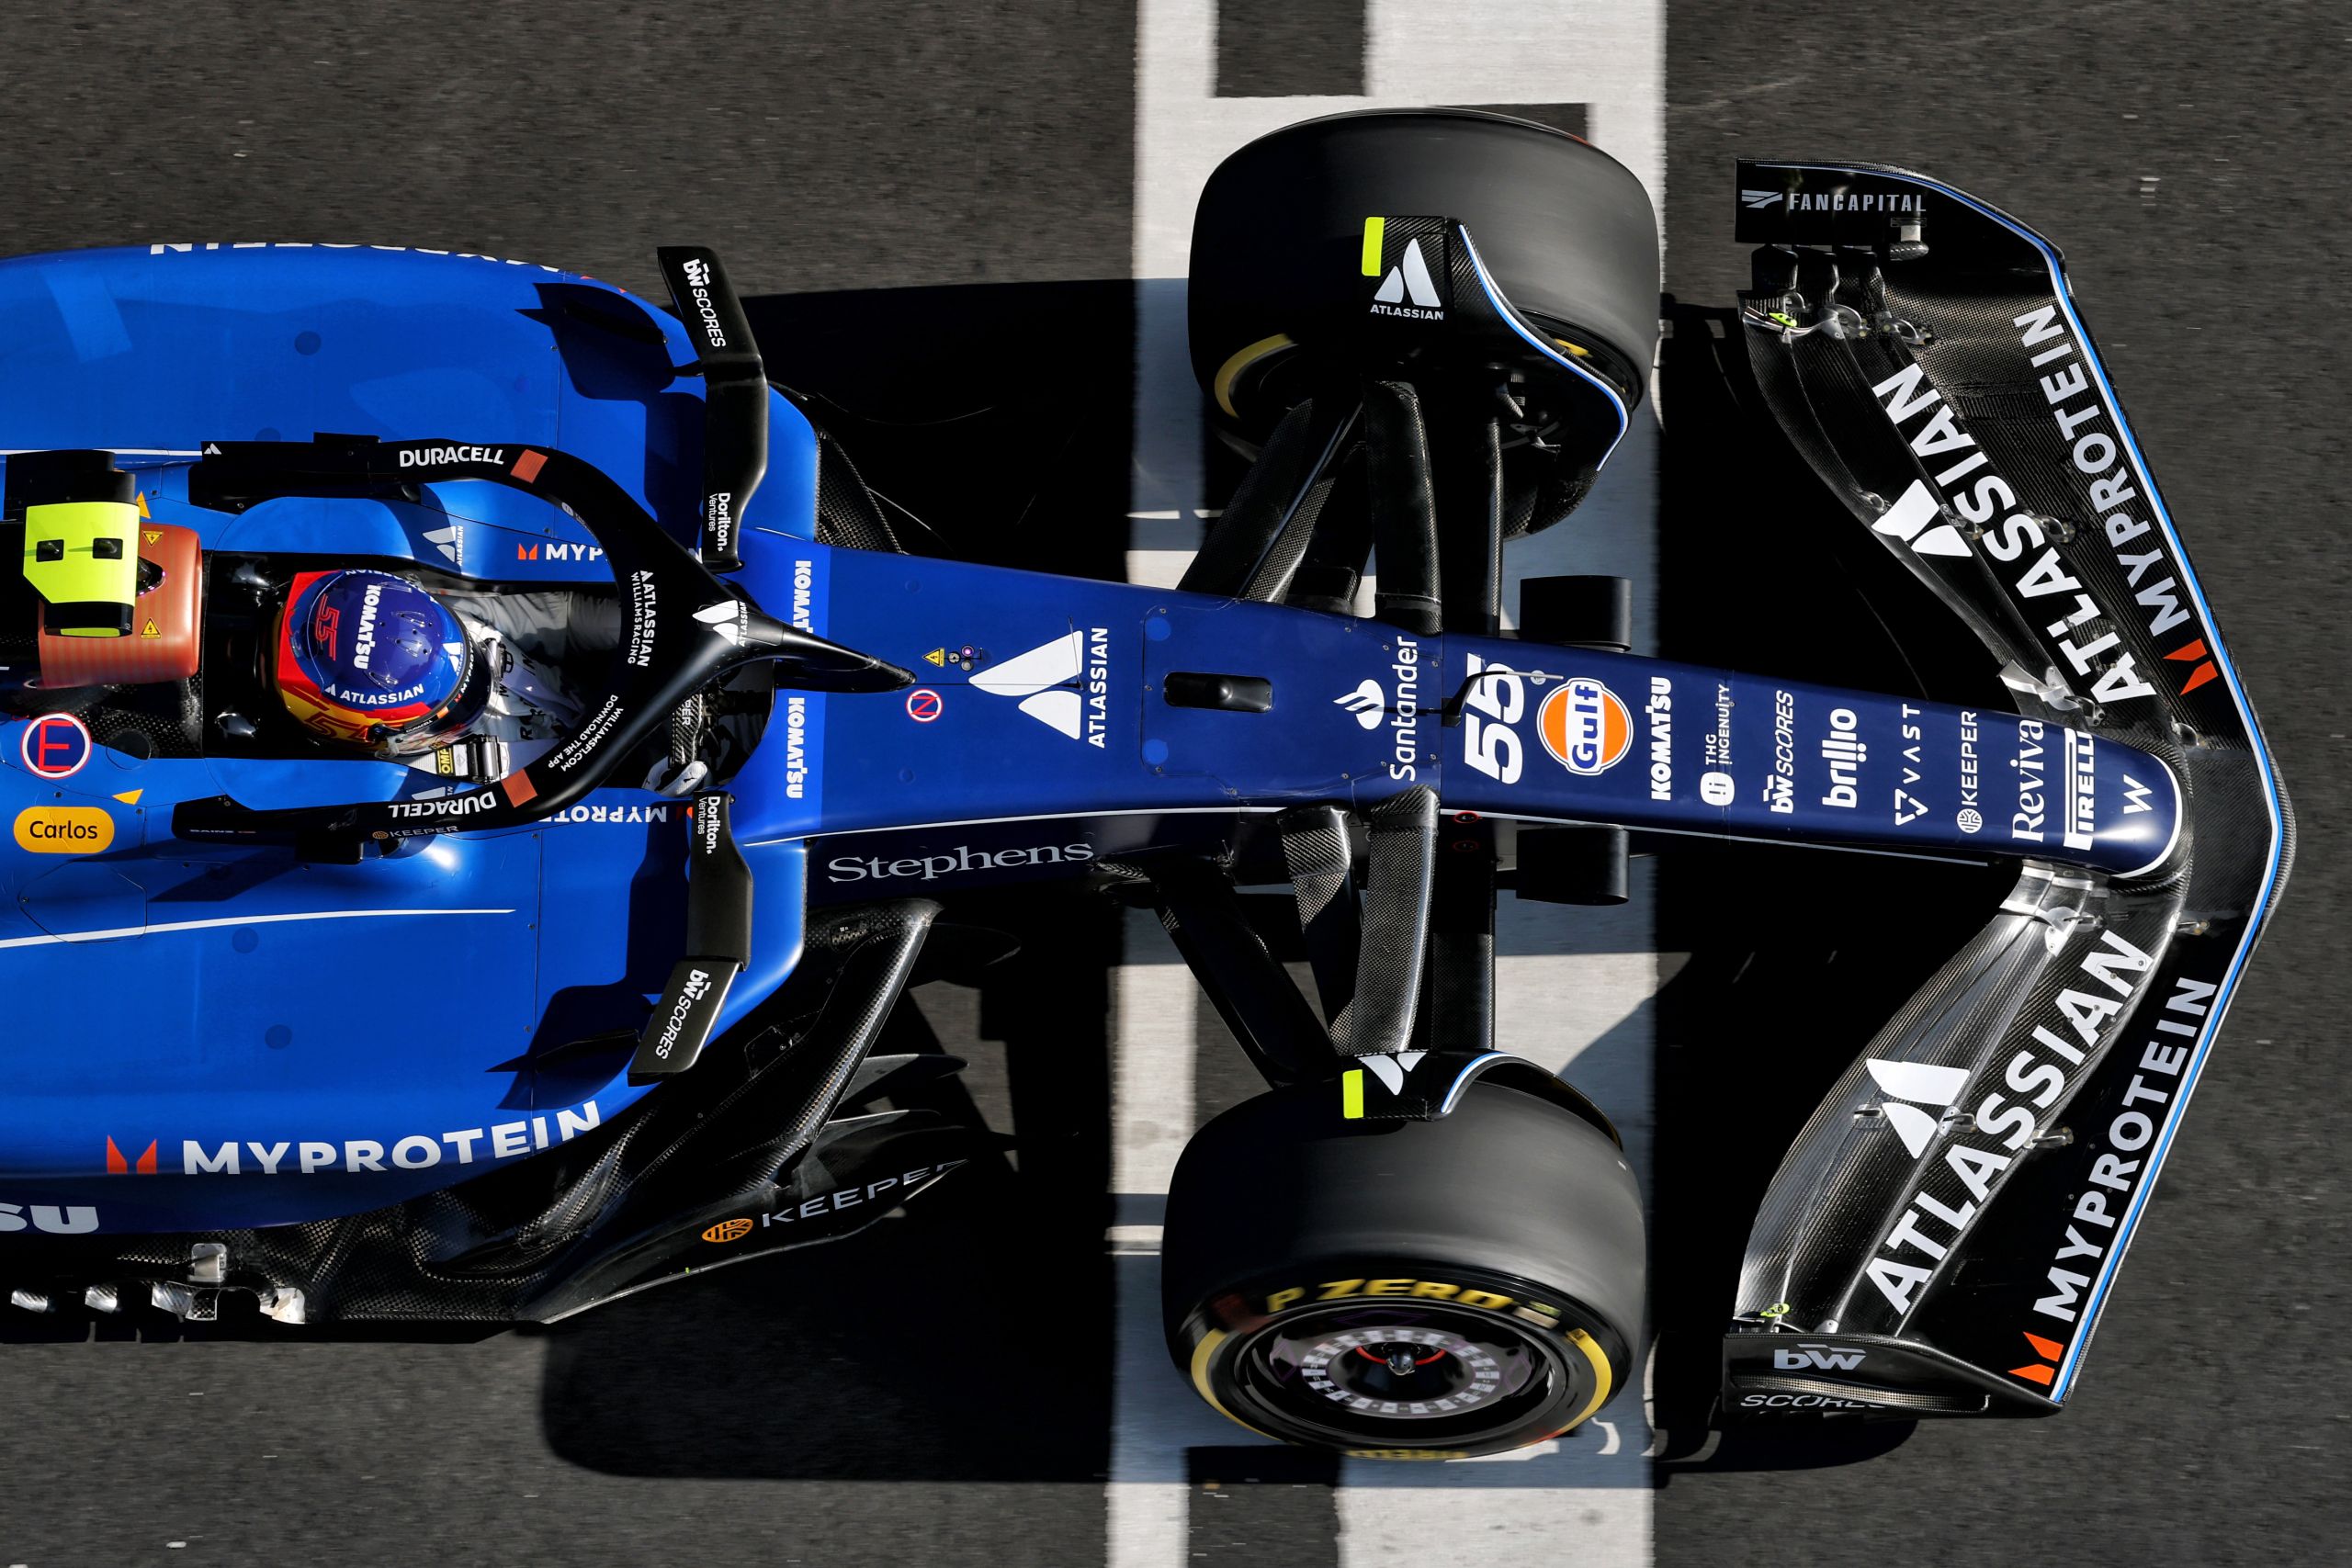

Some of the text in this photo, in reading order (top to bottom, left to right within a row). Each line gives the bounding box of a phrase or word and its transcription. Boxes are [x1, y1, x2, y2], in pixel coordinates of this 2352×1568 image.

[1789, 193, 1927, 212] FANCAPITAL
[692, 288, 727, 348] SCORES
[1370, 304, 1444, 321] ATLASSIAN
[399, 446, 504, 468] DURACELL
[2013, 305, 2190, 637] MYPROTEIN
[708, 493, 718, 532] Ventures
[1872, 363, 2156, 703] ATLASSIAN
[354, 584, 382, 670] KOMATSU
[628, 571, 642, 665] WILLIAMS RACING
[637, 581, 657, 668] ATLASSIAN
[738, 601, 750, 647] ATLASSIAN
[793, 560, 814, 634] KOMAT
[340, 682, 424, 705] ATLASSIAN
[1088, 627, 1108, 749] ATLASSIAN
[1389, 636, 1419, 782] Santander
[1464, 652, 1525, 784] 55
[548, 694, 618, 768] DOWNLOAD THE APP
[560, 707, 624, 772] WILLIAMSF1.COM
[786, 697, 808, 799] KOMATSU
[1572, 684, 1599, 770] Gulf
[1645, 676, 1672, 801] KOMATSU
[1705, 734, 1717, 765] THG
[1775, 690, 1793, 776] SCORES
[1961, 711, 1978, 807] KEEPER
[388, 791, 497, 818] DURACELL
[697, 796, 707, 835] Ventures
[2009, 719, 2045, 842] Reviva
[2063, 728, 2095, 851] PIRELLI
[29, 820, 98, 840] Carlos
[390, 825, 459, 838] KEEPER
[828, 842, 1095, 883] Stephens
[656, 996, 692, 1060] SCORES
[183, 1100, 602, 1176] MYPROTEIN
[1866, 930, 2154, 1315] ATLASSIAN
[2033, 977, 2218, 1323] MYPROTEIN
[1266, 1286, 1306, 1314] P
[1315, 1278, 1516, 1310] ZERO
